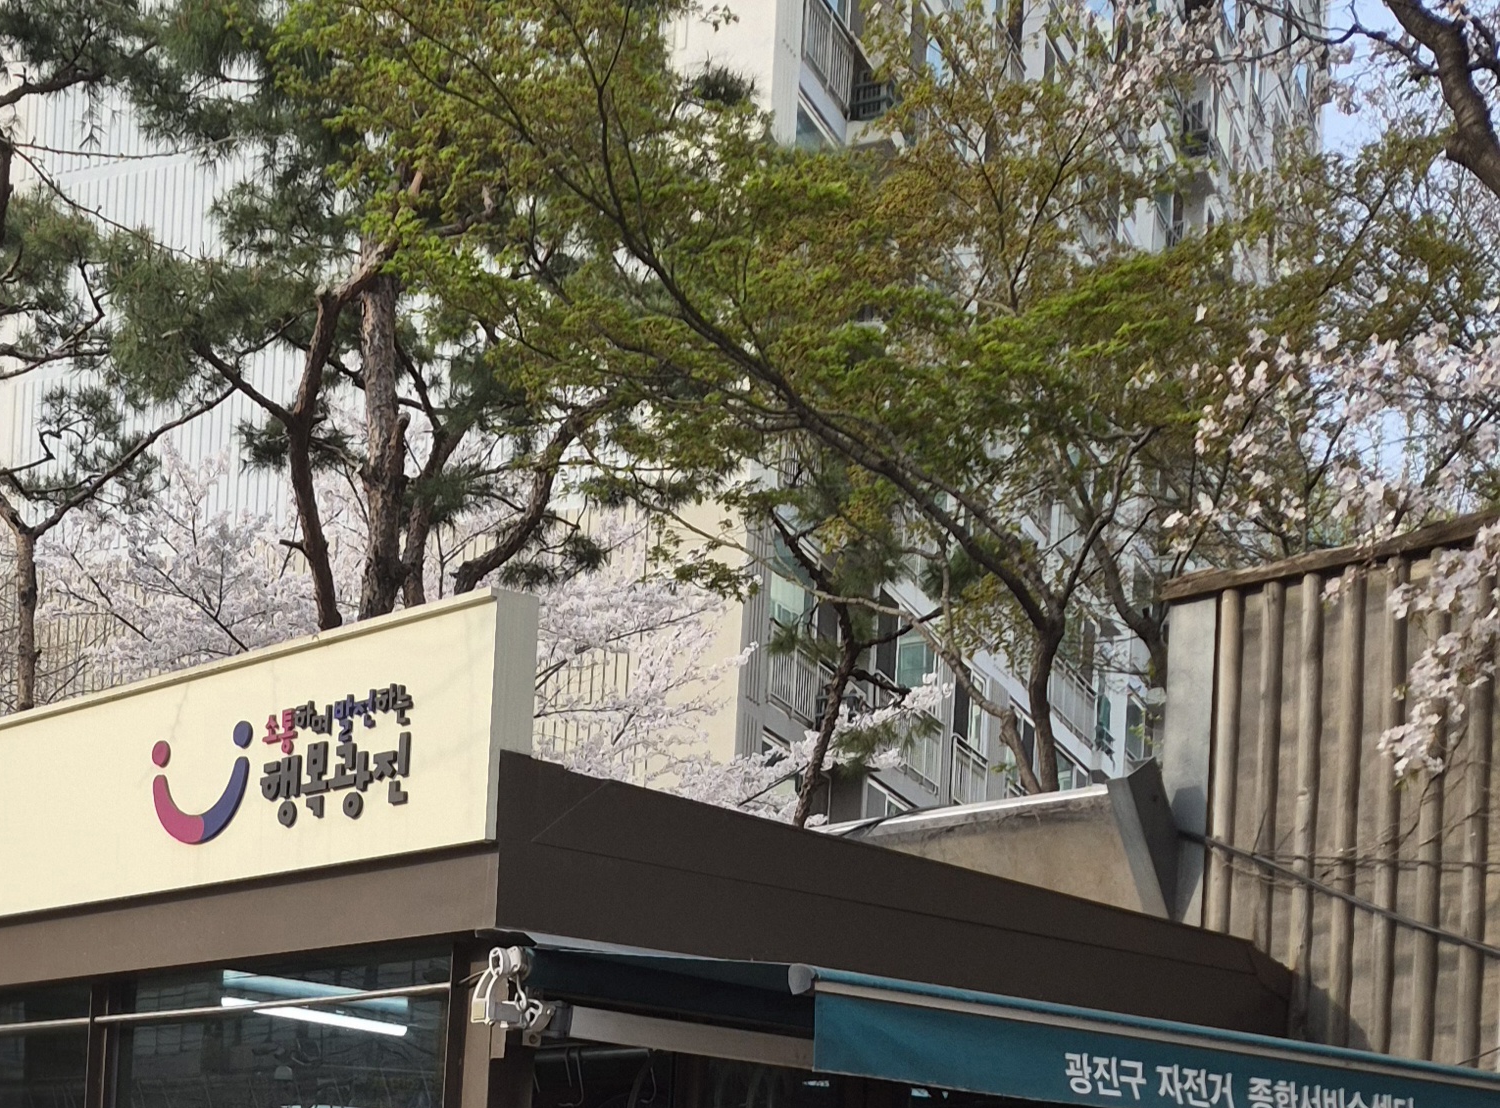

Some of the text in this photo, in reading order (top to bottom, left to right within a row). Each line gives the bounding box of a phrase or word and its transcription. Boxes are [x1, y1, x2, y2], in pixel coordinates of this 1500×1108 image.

[262, 683, 413, 755] 소통하며 발전하는
[260, 731, 412, 828] 행복광진
[1064, 1052, 1147, 1100] 광진구
